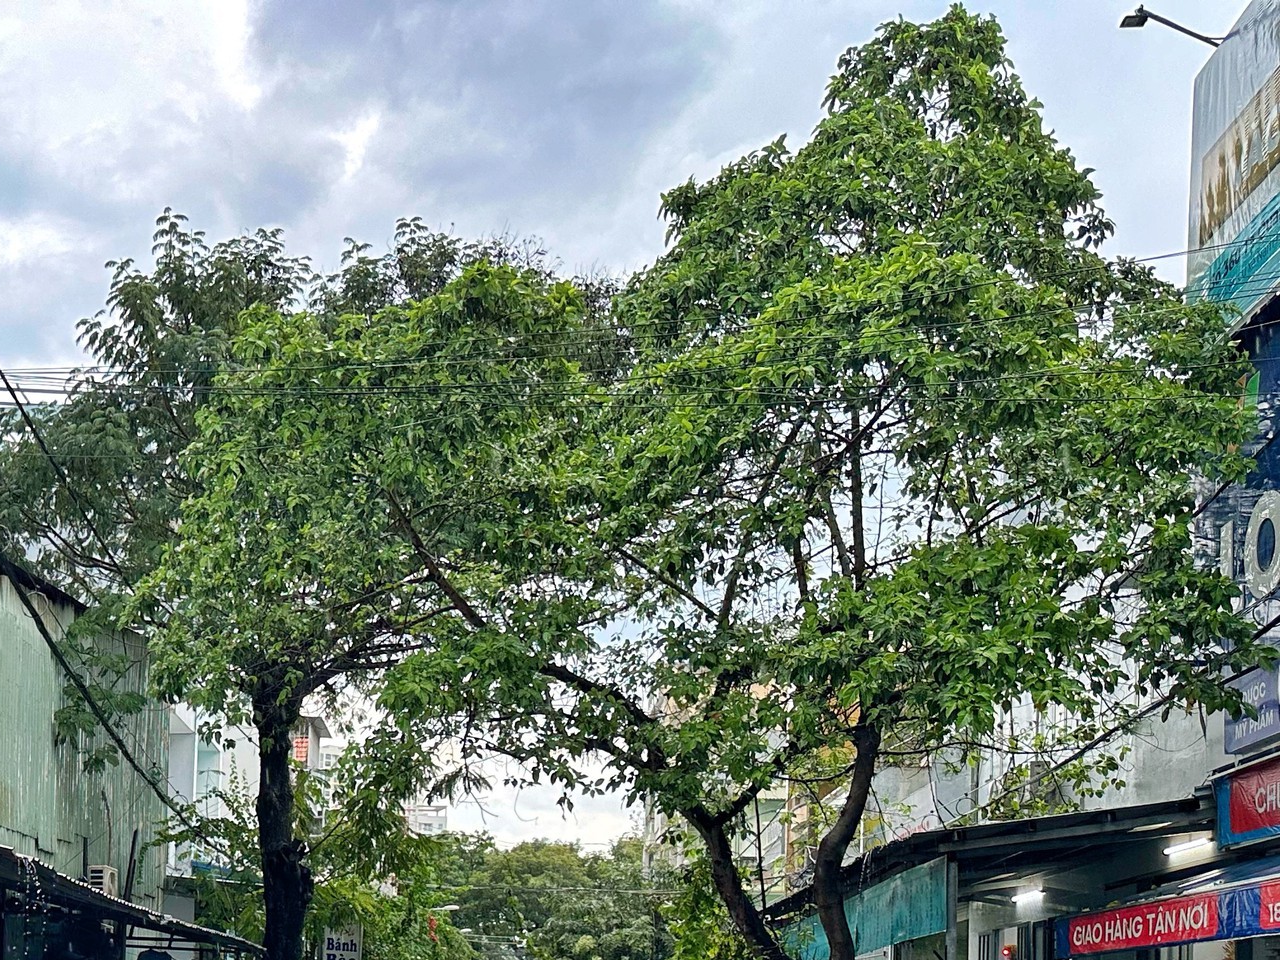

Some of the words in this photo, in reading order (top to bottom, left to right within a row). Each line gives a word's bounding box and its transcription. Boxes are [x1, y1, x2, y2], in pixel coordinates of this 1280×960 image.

[1073, 923, 1103, 946] GIAO
[1105, 914, 1143, 942] HÀNG
[1146, 905, 1176, 942] TẬN
[326, 937, 358, 952] Bánh
